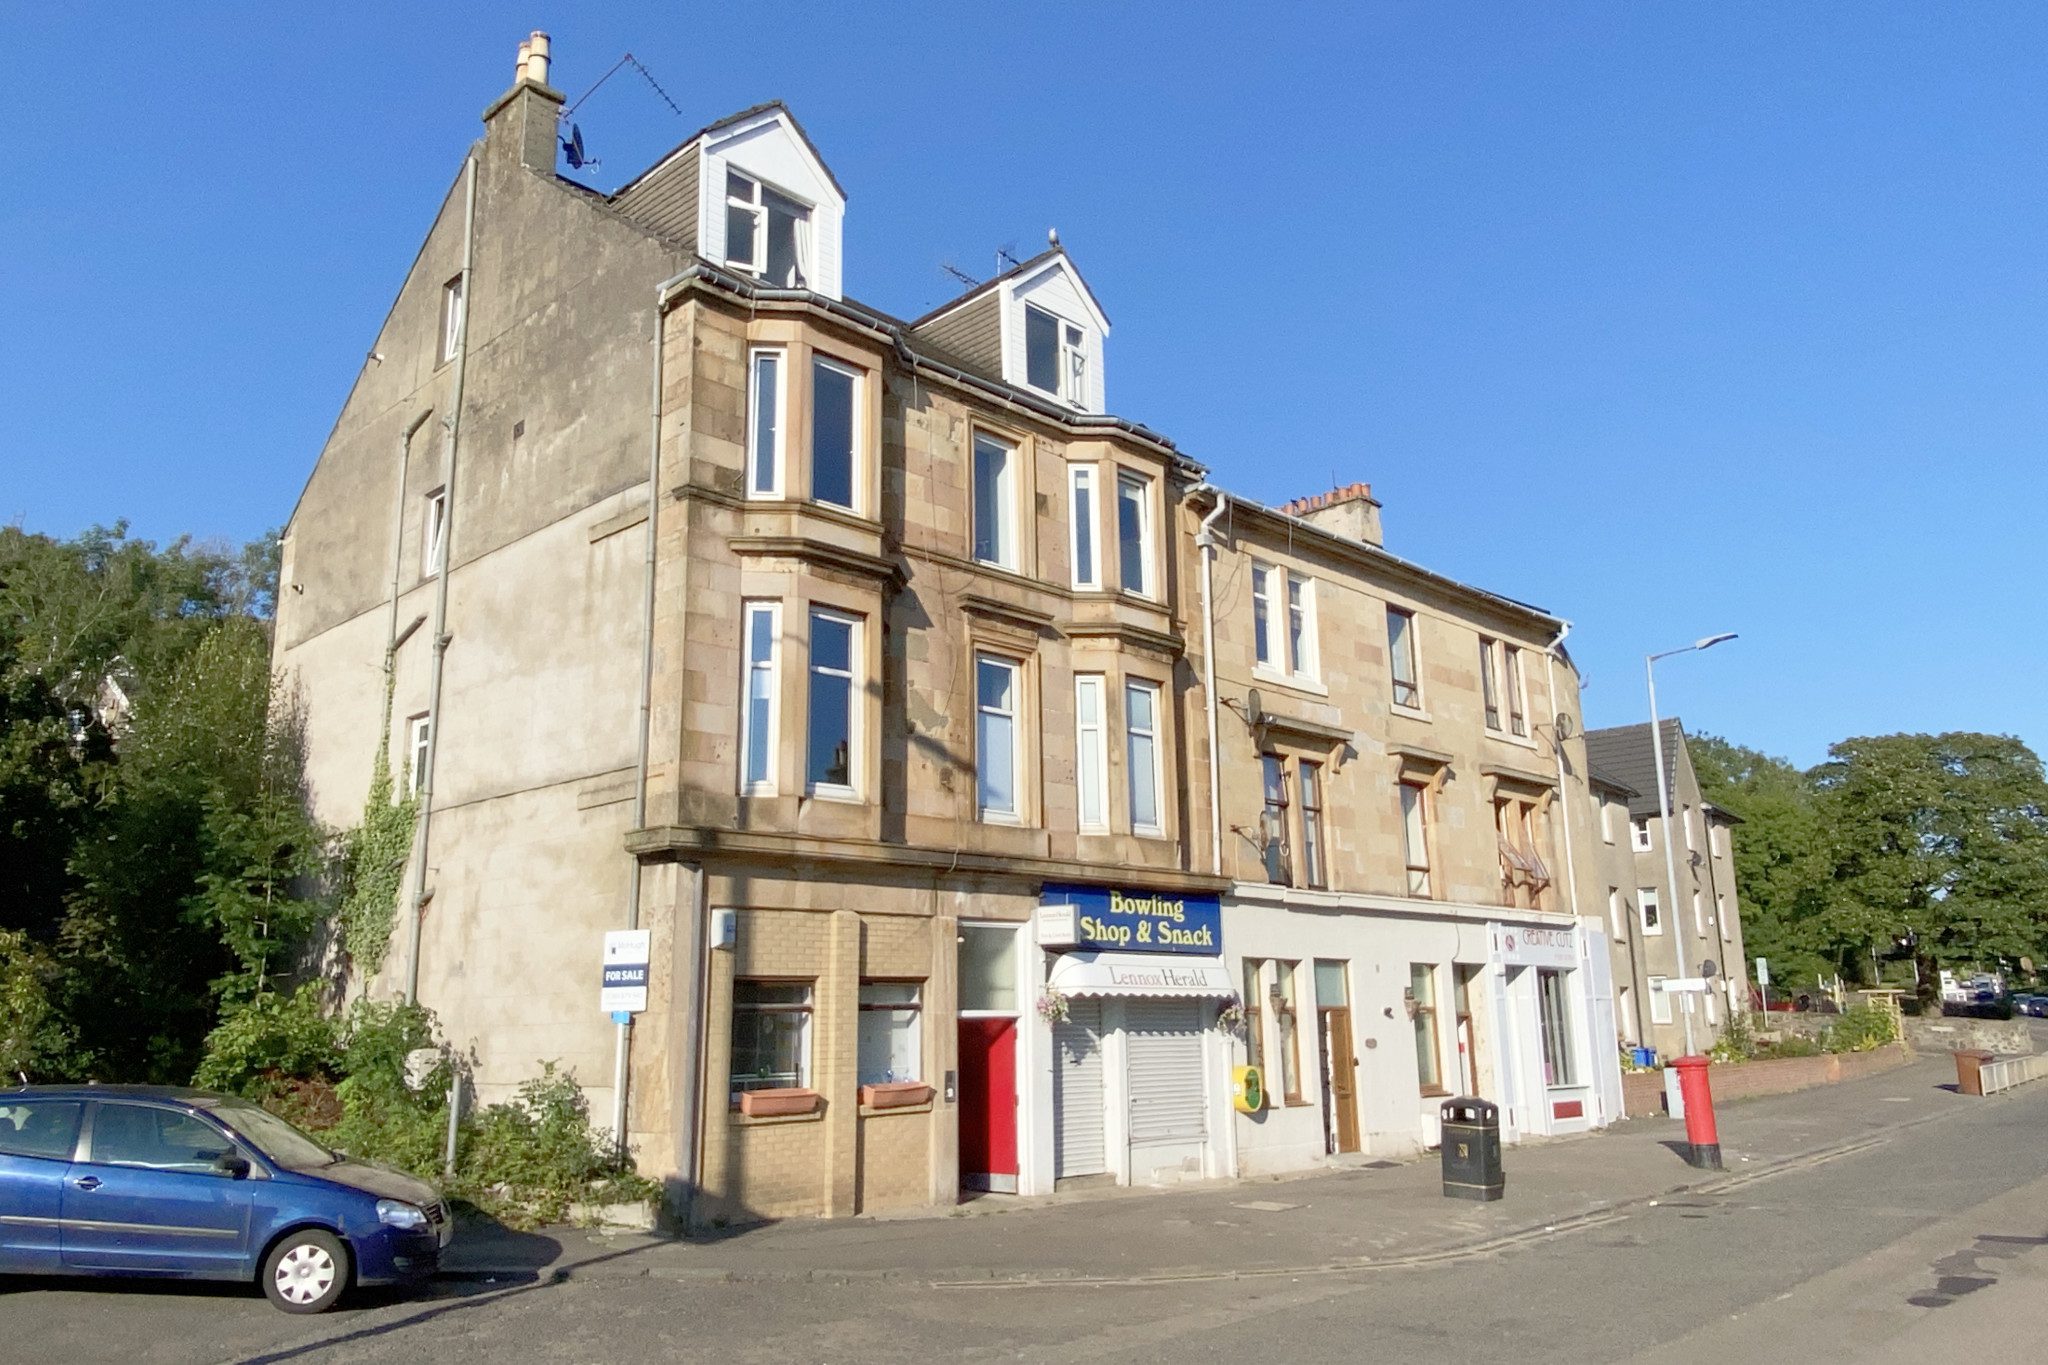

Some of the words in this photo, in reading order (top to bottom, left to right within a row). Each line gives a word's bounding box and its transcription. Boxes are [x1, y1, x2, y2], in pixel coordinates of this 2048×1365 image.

[1110, 890, 1185, 922] Bowling
[1080, 916, 1131, 946] Shop
[1136, 920, 1152, 943] &
[1157, 921, 1213, 946] Snack
[605, 970, 621, 981] FOR
[621, 970, 644, 981] SALE
[1109, 966, 1162, 985] Lennox
[1162, 969, 1208, 987] Herald
